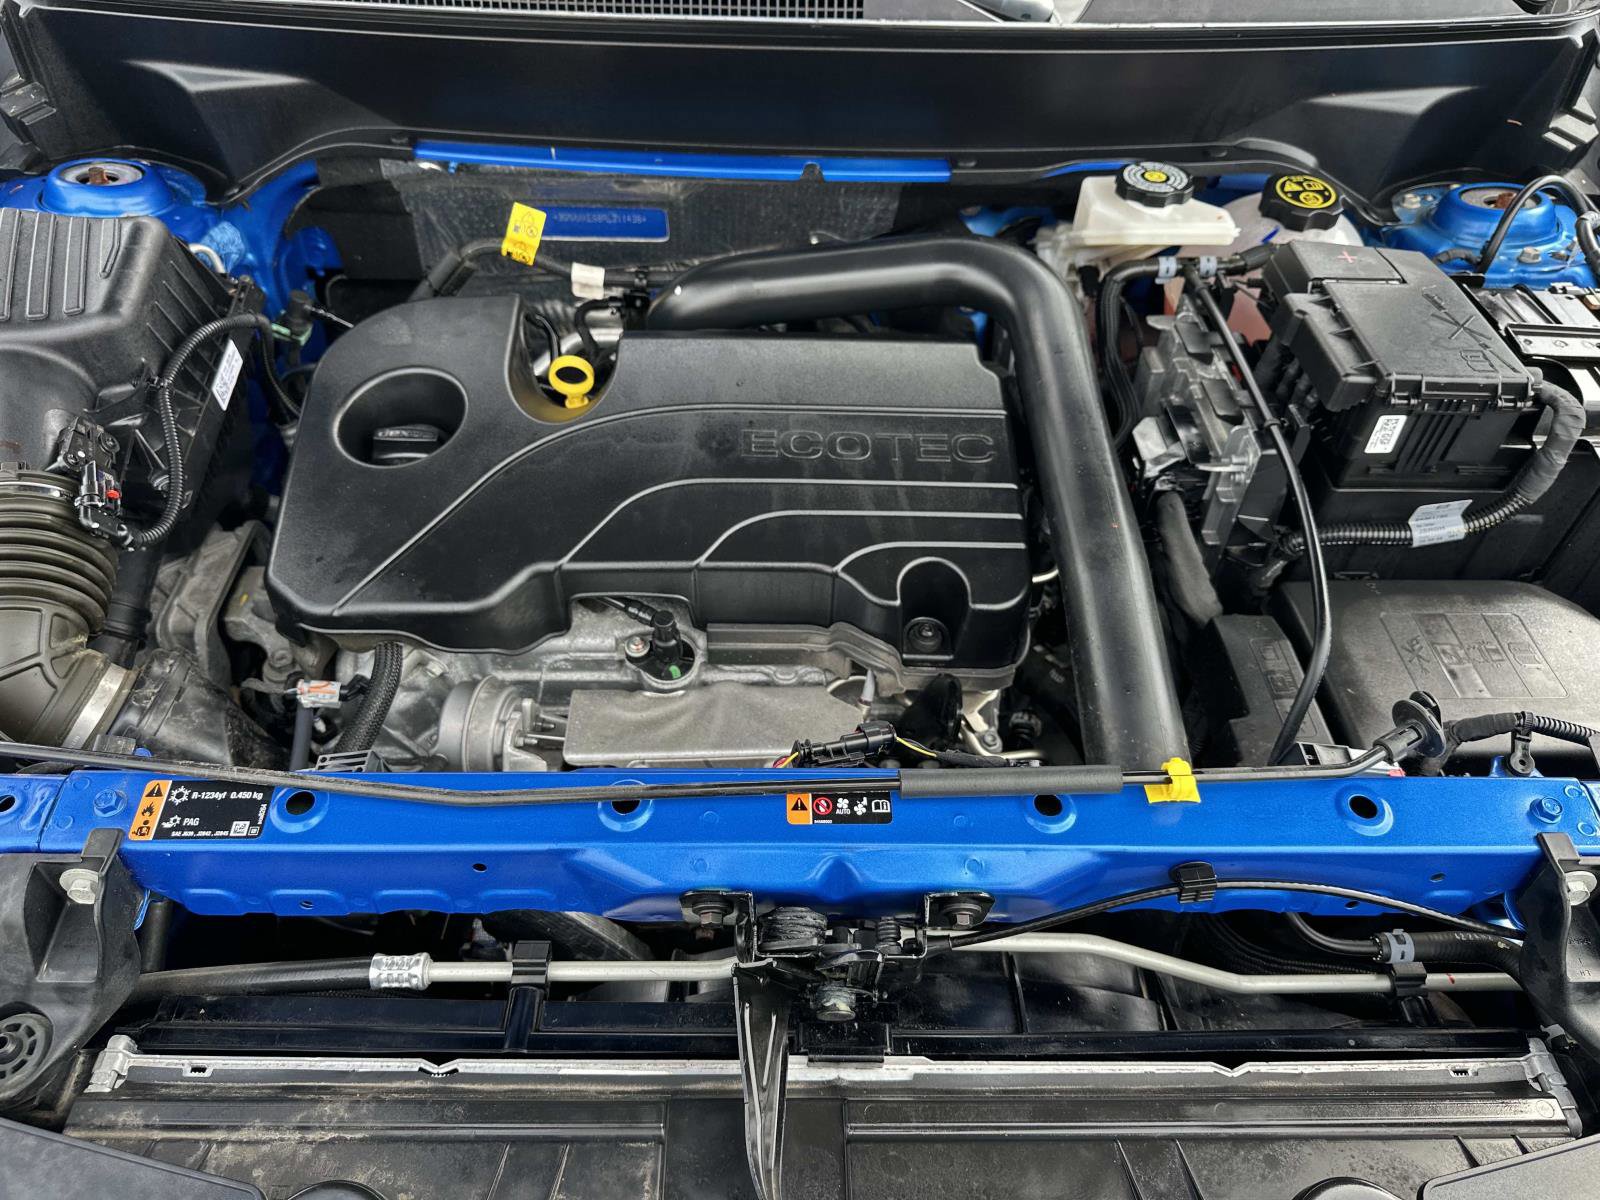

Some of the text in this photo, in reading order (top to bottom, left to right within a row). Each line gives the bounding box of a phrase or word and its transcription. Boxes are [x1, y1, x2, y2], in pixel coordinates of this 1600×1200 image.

[740, 429, 996, 464] ECOTEC
[191, 791, 264, 801] R-1234yf 0.450 kg
[182, 817, 200, 826] PAG
